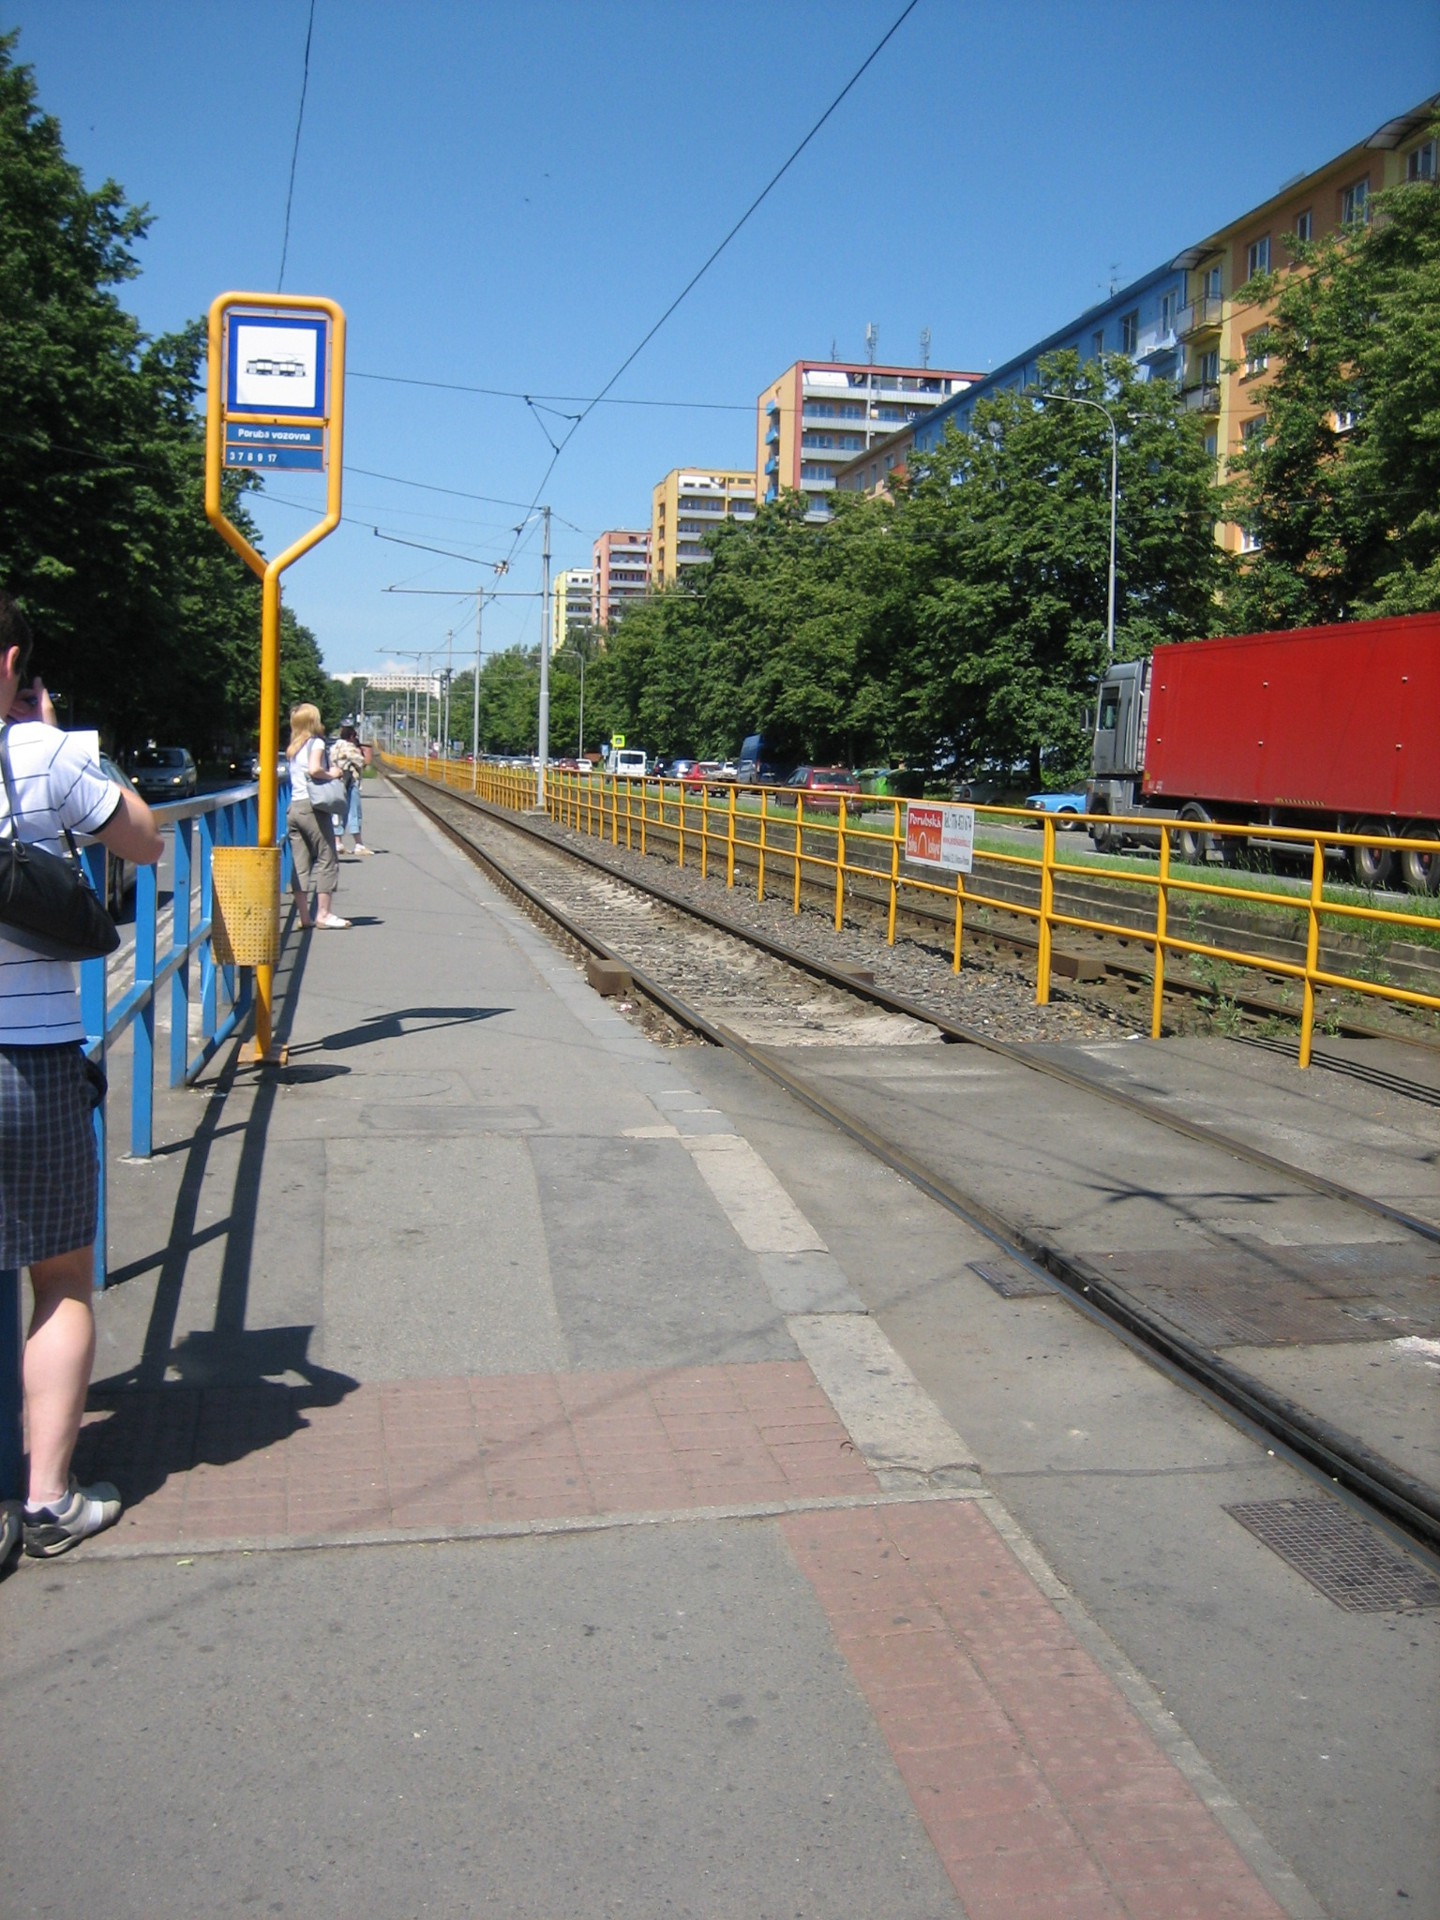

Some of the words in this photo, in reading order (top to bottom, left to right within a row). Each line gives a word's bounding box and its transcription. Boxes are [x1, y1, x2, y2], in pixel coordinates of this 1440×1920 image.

[238, 428, 270, 439] Poruba
[271, 431, 311, 441] vozovna
[229, 451, 236, 461] 3
[238, 452, 244, 461] 7
[257, 453, 263, 462] 9
[268, 453, 278, 463] 17
